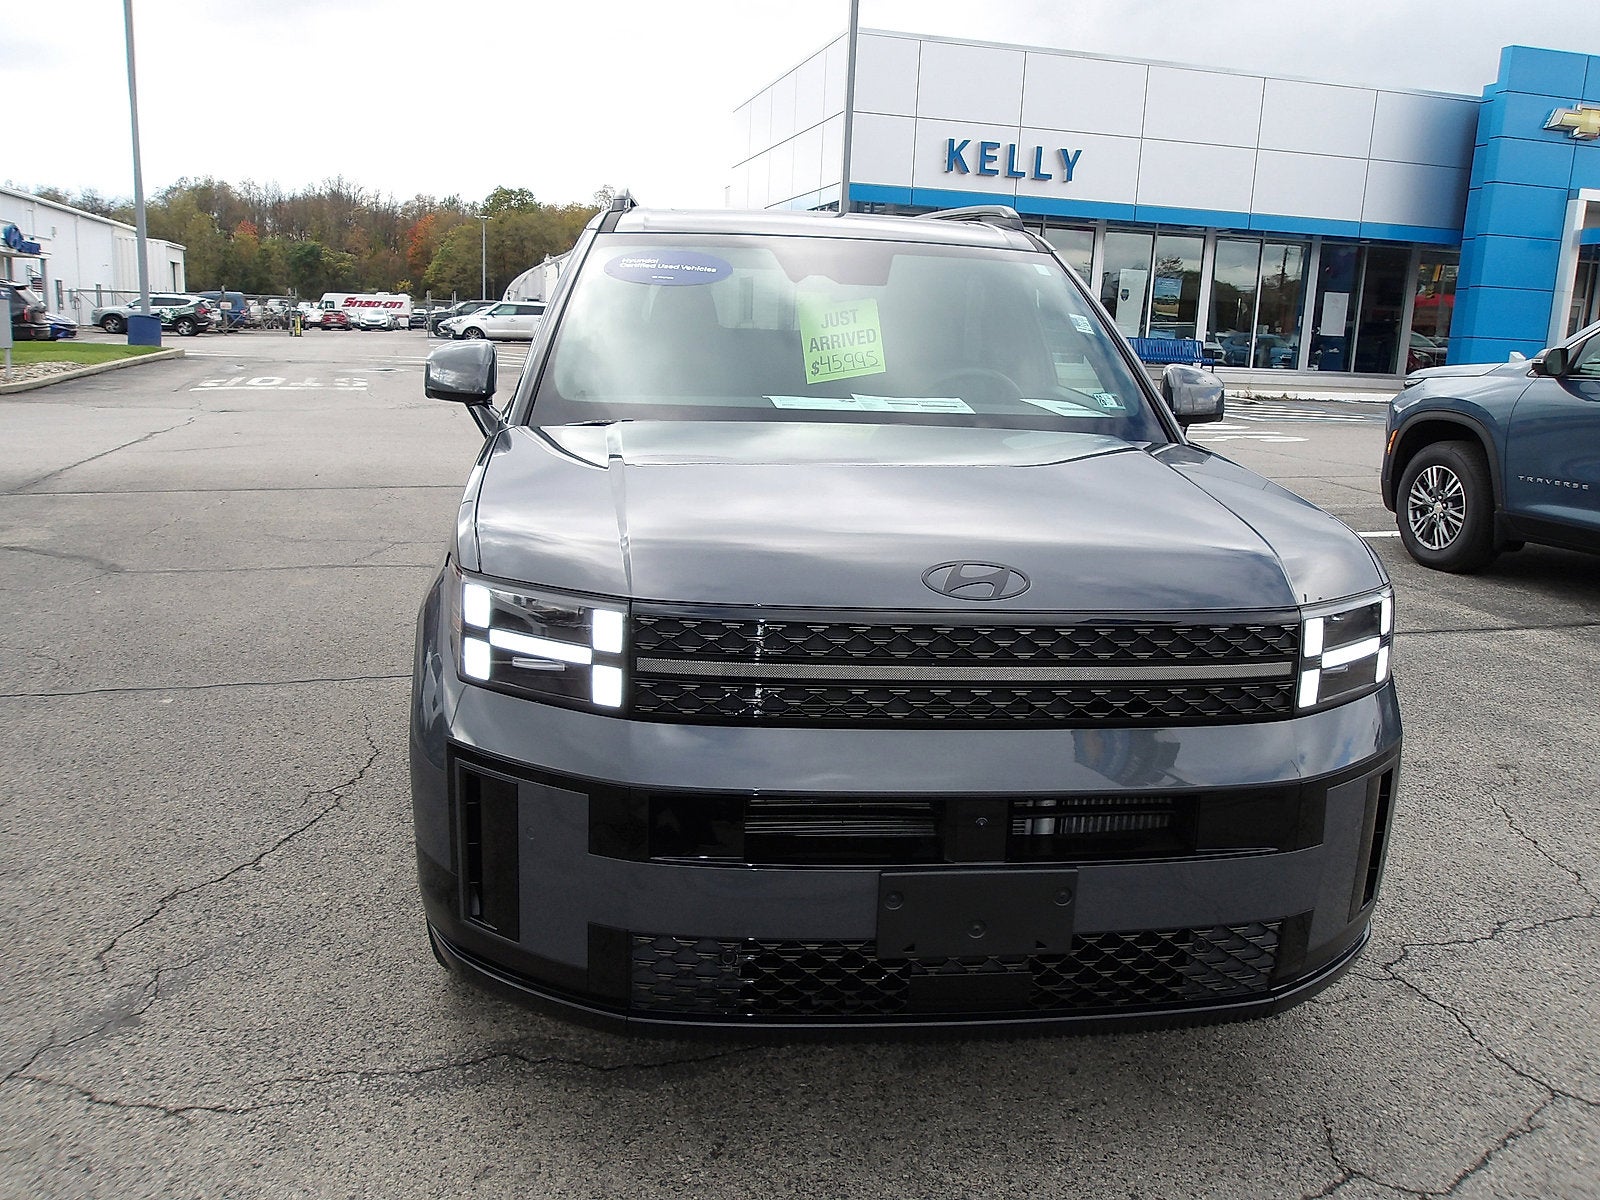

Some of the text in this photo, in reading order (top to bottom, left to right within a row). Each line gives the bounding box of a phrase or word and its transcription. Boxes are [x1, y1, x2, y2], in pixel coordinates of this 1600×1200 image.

[945, 138, 1082, 182] KELLY
[681, 264, 717, 273] Vehicles
[341, 297, 404, 309] Snap-on
[821, 309, 859, 329] JUST
[809, 328, 877, 353] ARRIVED
[1518, 475, 1589, 490] TRAVERSE
